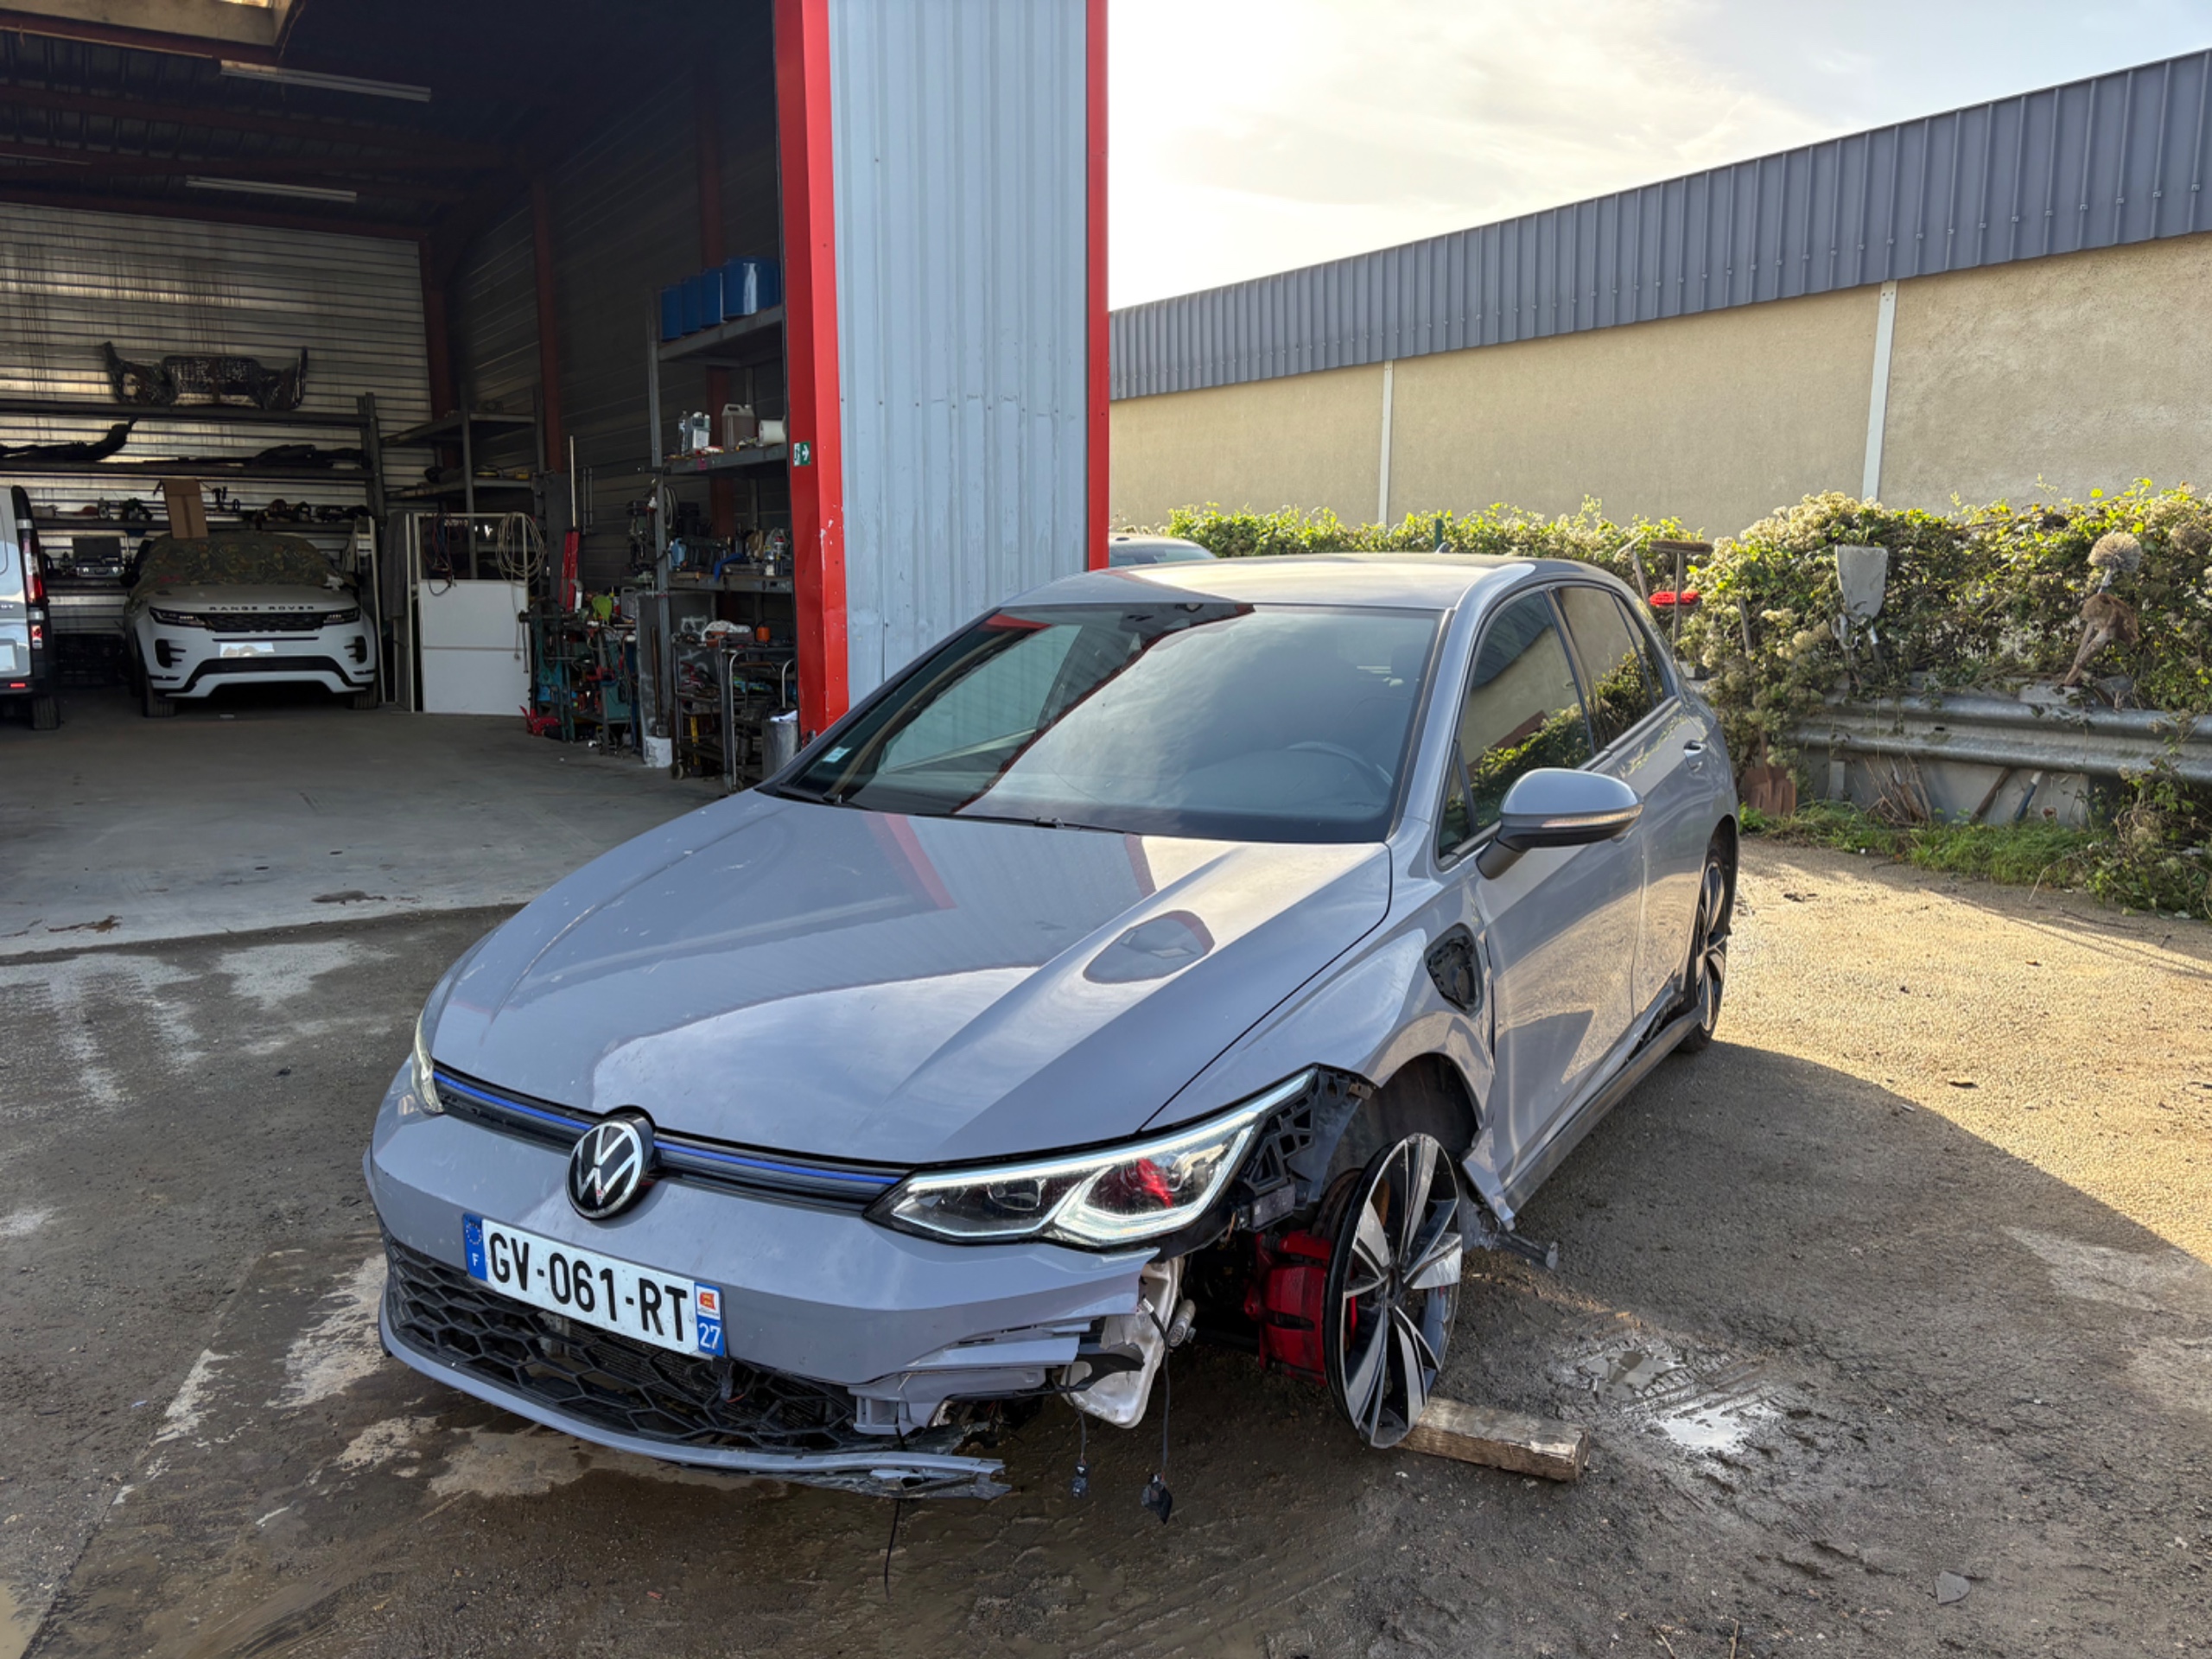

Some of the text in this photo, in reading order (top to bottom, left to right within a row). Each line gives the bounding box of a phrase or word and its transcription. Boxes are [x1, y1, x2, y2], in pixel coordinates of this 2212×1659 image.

[567, 1121, 643, 1219] VW
[472, 1253, 480, 1267] F
[489, 1232, 688, 1342] GV-061-RT
[698, 1322, 721, 1350] 27
